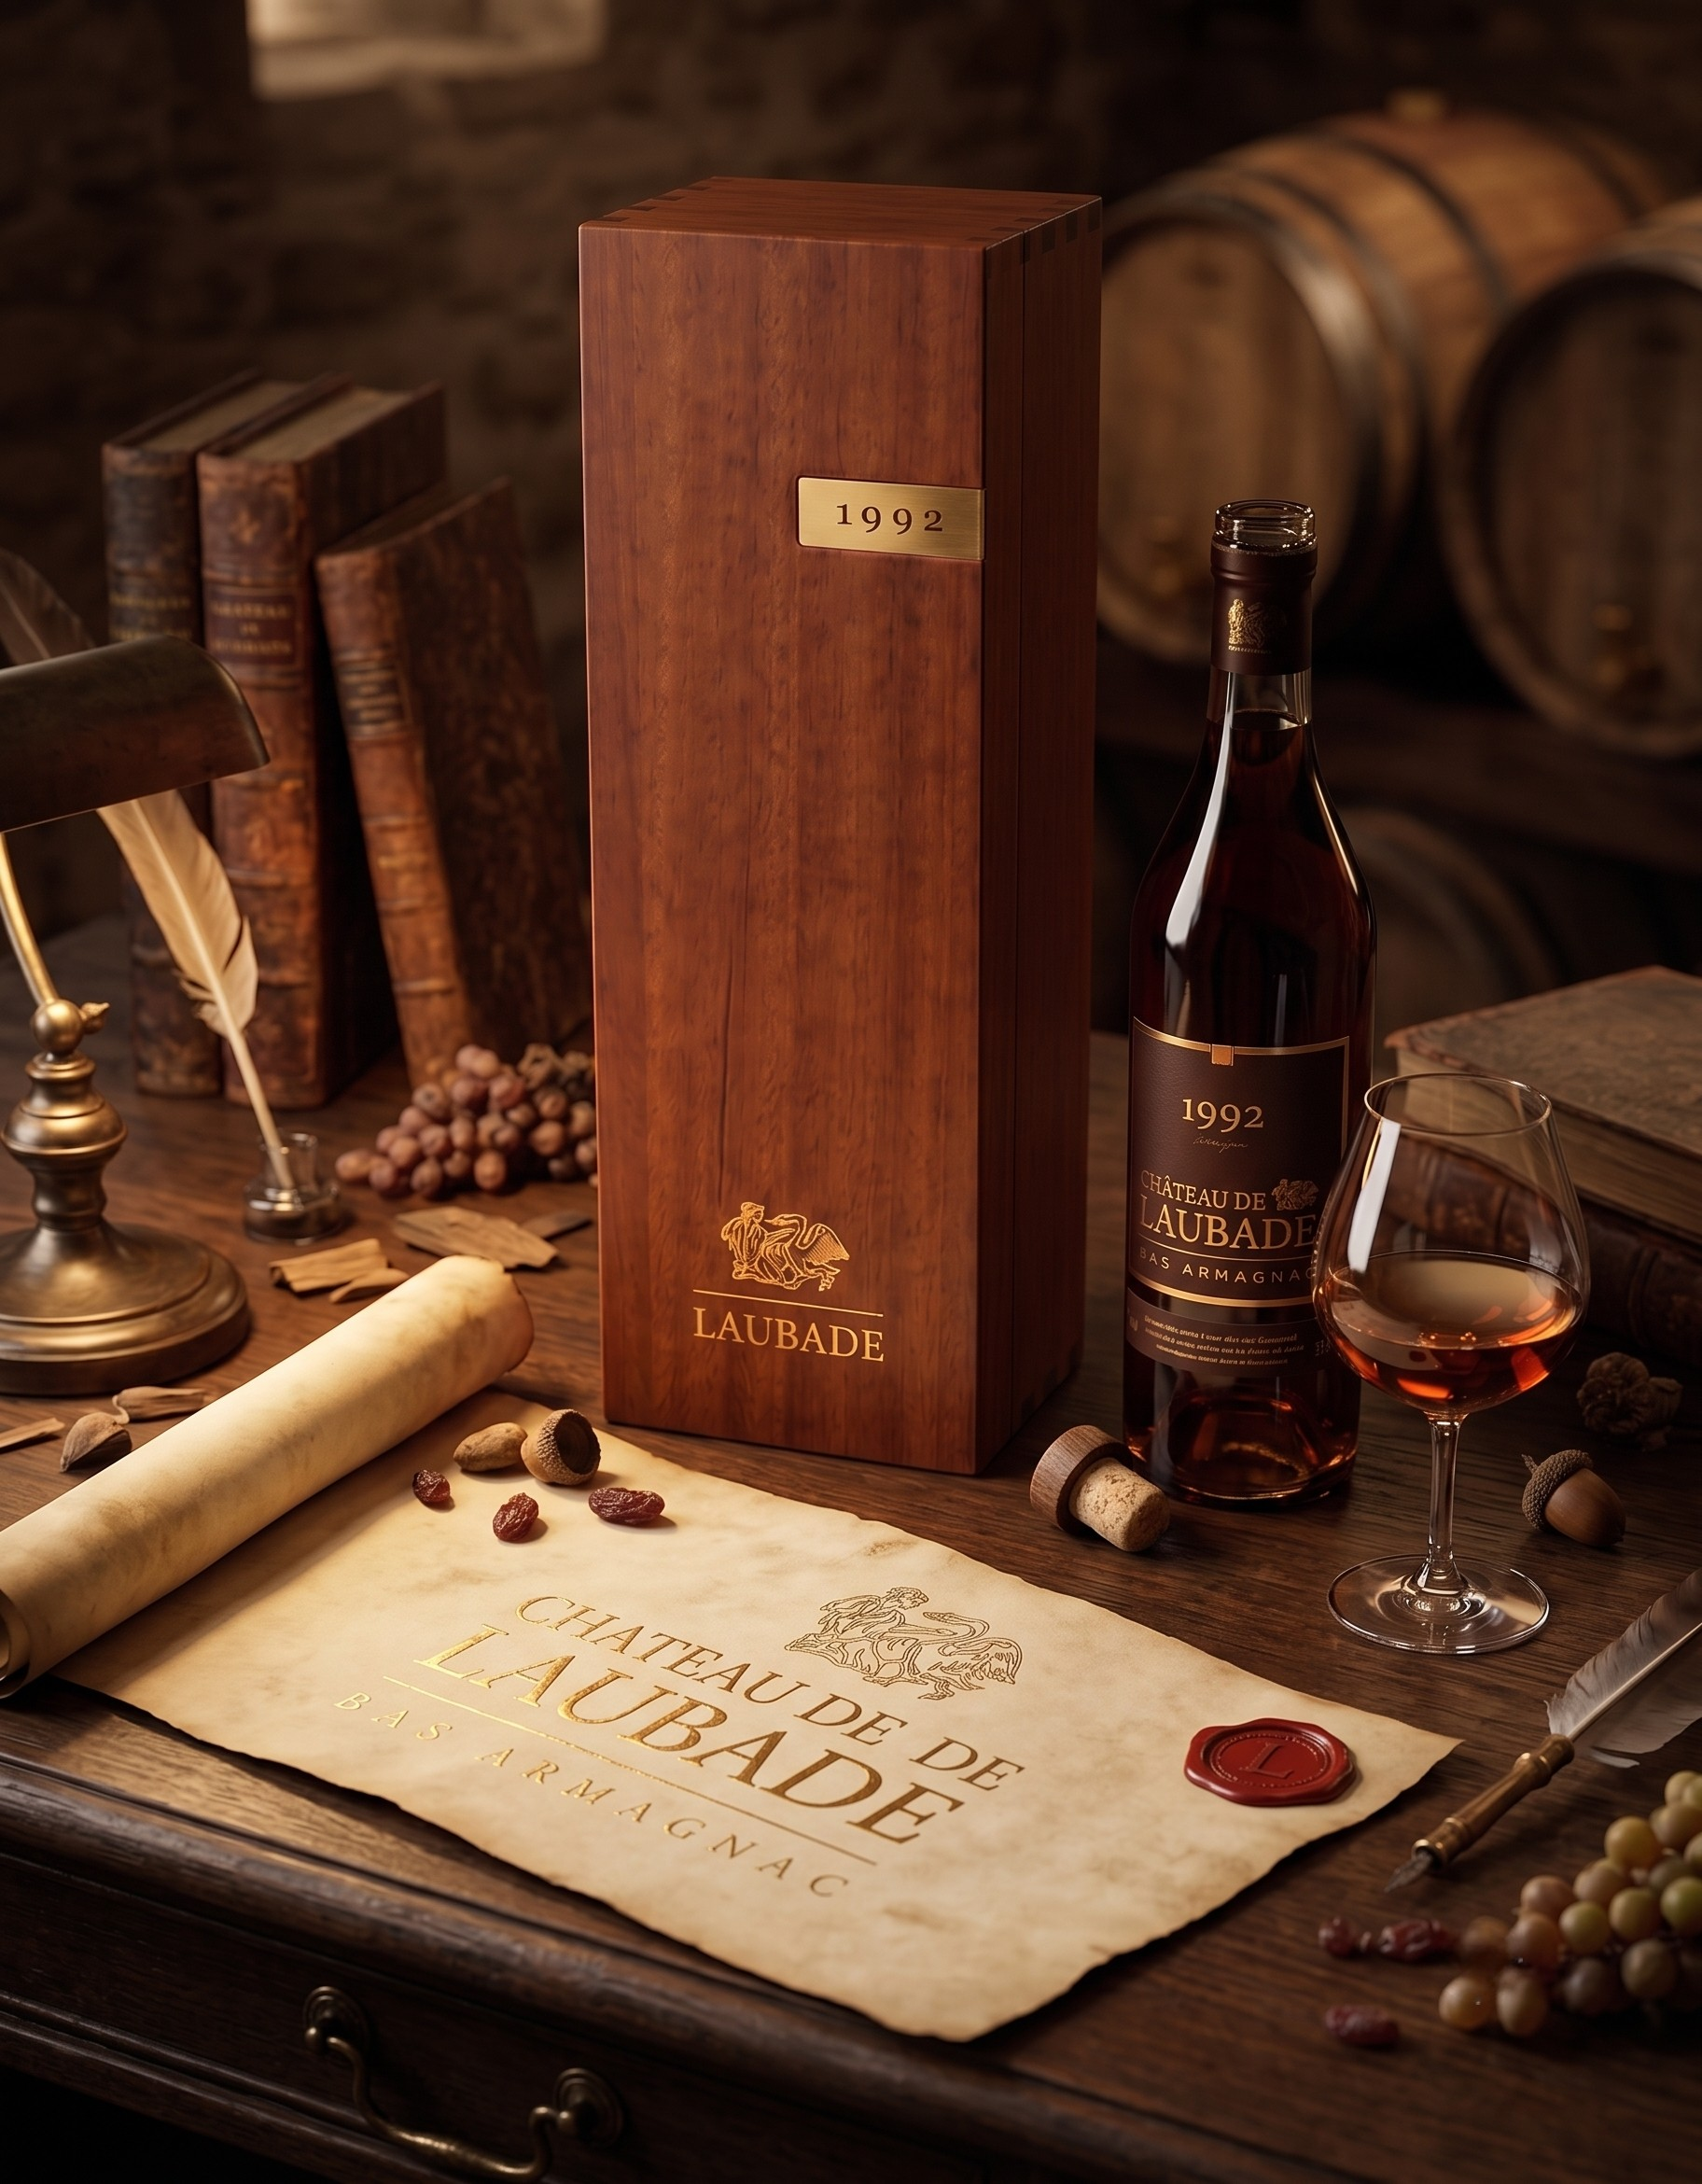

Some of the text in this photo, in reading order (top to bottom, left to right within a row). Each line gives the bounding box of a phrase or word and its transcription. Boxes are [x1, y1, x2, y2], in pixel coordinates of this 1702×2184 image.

[836, 503, 943, 536] 1992
[1181, 1099, 1263, 1133] 1992
[1141, 1169, 1266, 1211] CHÂTEAU DE
[1140, 1196, 1317, 1252] LAUBADE
[1139, 1247, 1170, 1269] BAS
[692, 1307, 884, 1363] LAUBADE
[514, 1595, 1025, 1792] CHATEAU DE DE
[412, 1622, 966, 1844] LAUBADE
[1238, 1742, 1295, 1780] L
[333, 1691, 850, 1899] BAS ARMAGNAC
